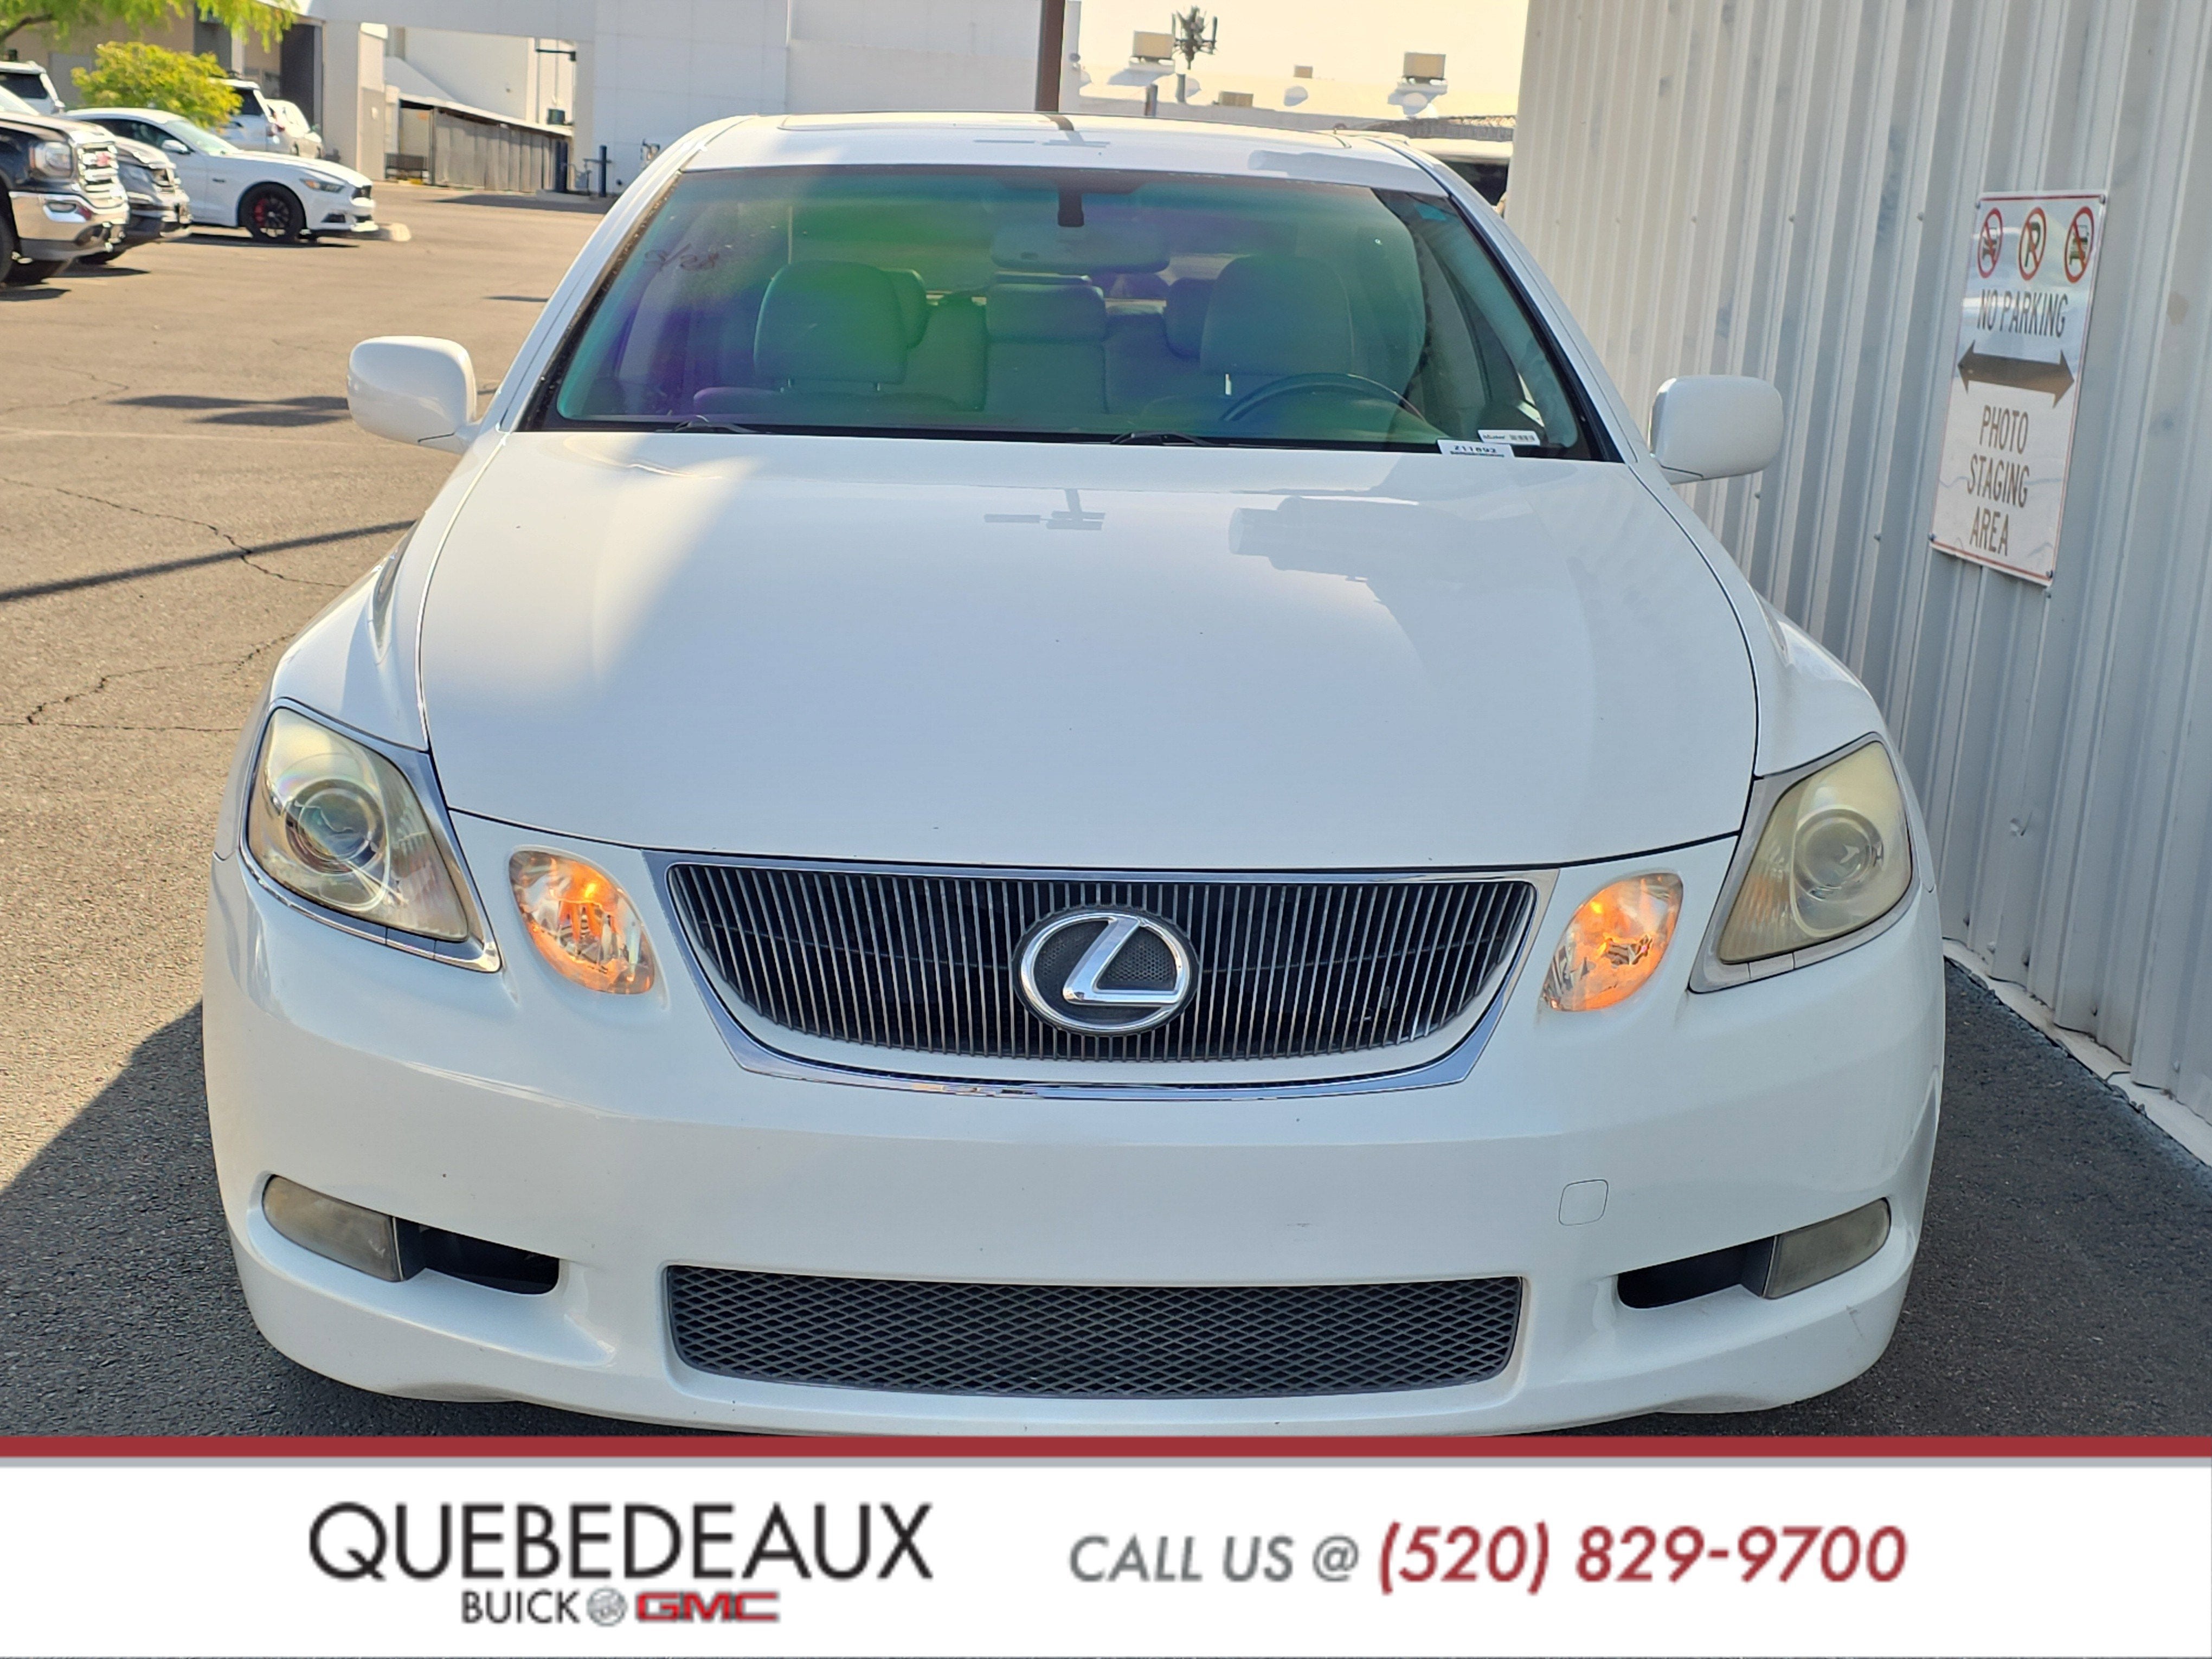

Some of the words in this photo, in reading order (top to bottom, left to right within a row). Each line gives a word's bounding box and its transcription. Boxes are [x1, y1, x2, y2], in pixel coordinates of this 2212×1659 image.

[1977, 288, 1998, 331] NO
[1999, 290, 2068, 338] PARKING
[1979, 404, 2029, 454] PHOTO
[1967, 453, 2030, 508] STAGING
[1969, 505, 2009, 556] AREA
